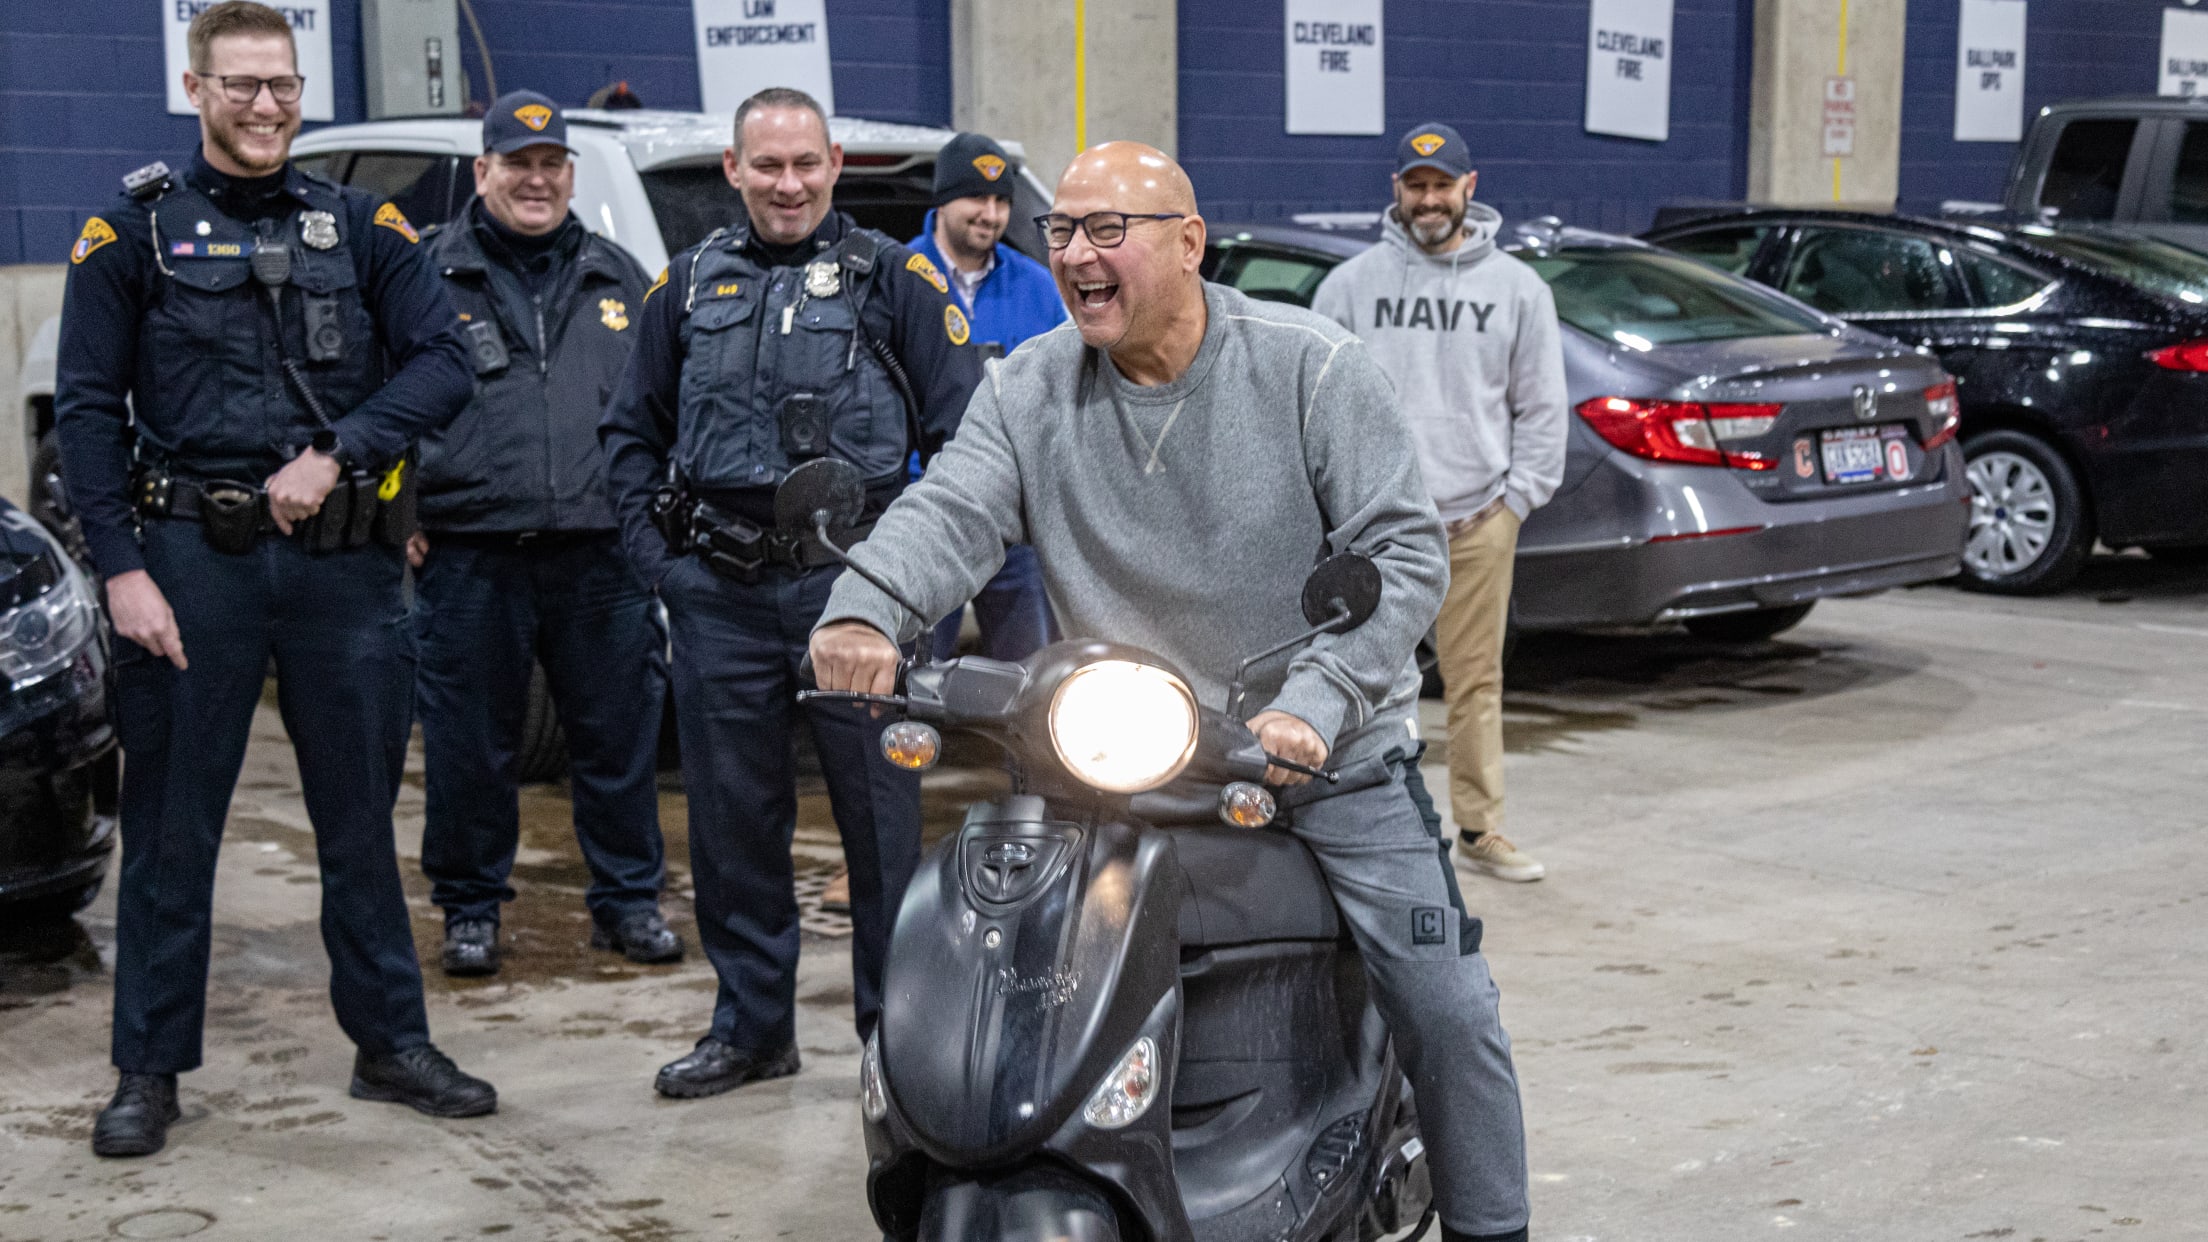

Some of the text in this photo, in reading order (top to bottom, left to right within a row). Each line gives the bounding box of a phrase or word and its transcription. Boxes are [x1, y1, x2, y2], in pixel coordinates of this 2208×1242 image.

[706, 23, 815, 47] ENFORCEMENT
[1294, 22, 1374, 46] CLEVELAND
[1597, 30, 1664, 58] CLEVELAND
[1319, 51, 1350, 72] FIRE
[1617, 59, 1642, 80] FIRE
[1967, 50, 2016, 68] BALLPARK
[1374, 297, 1497, 332] NAVY
[1421, 912, 1436, 933] C
